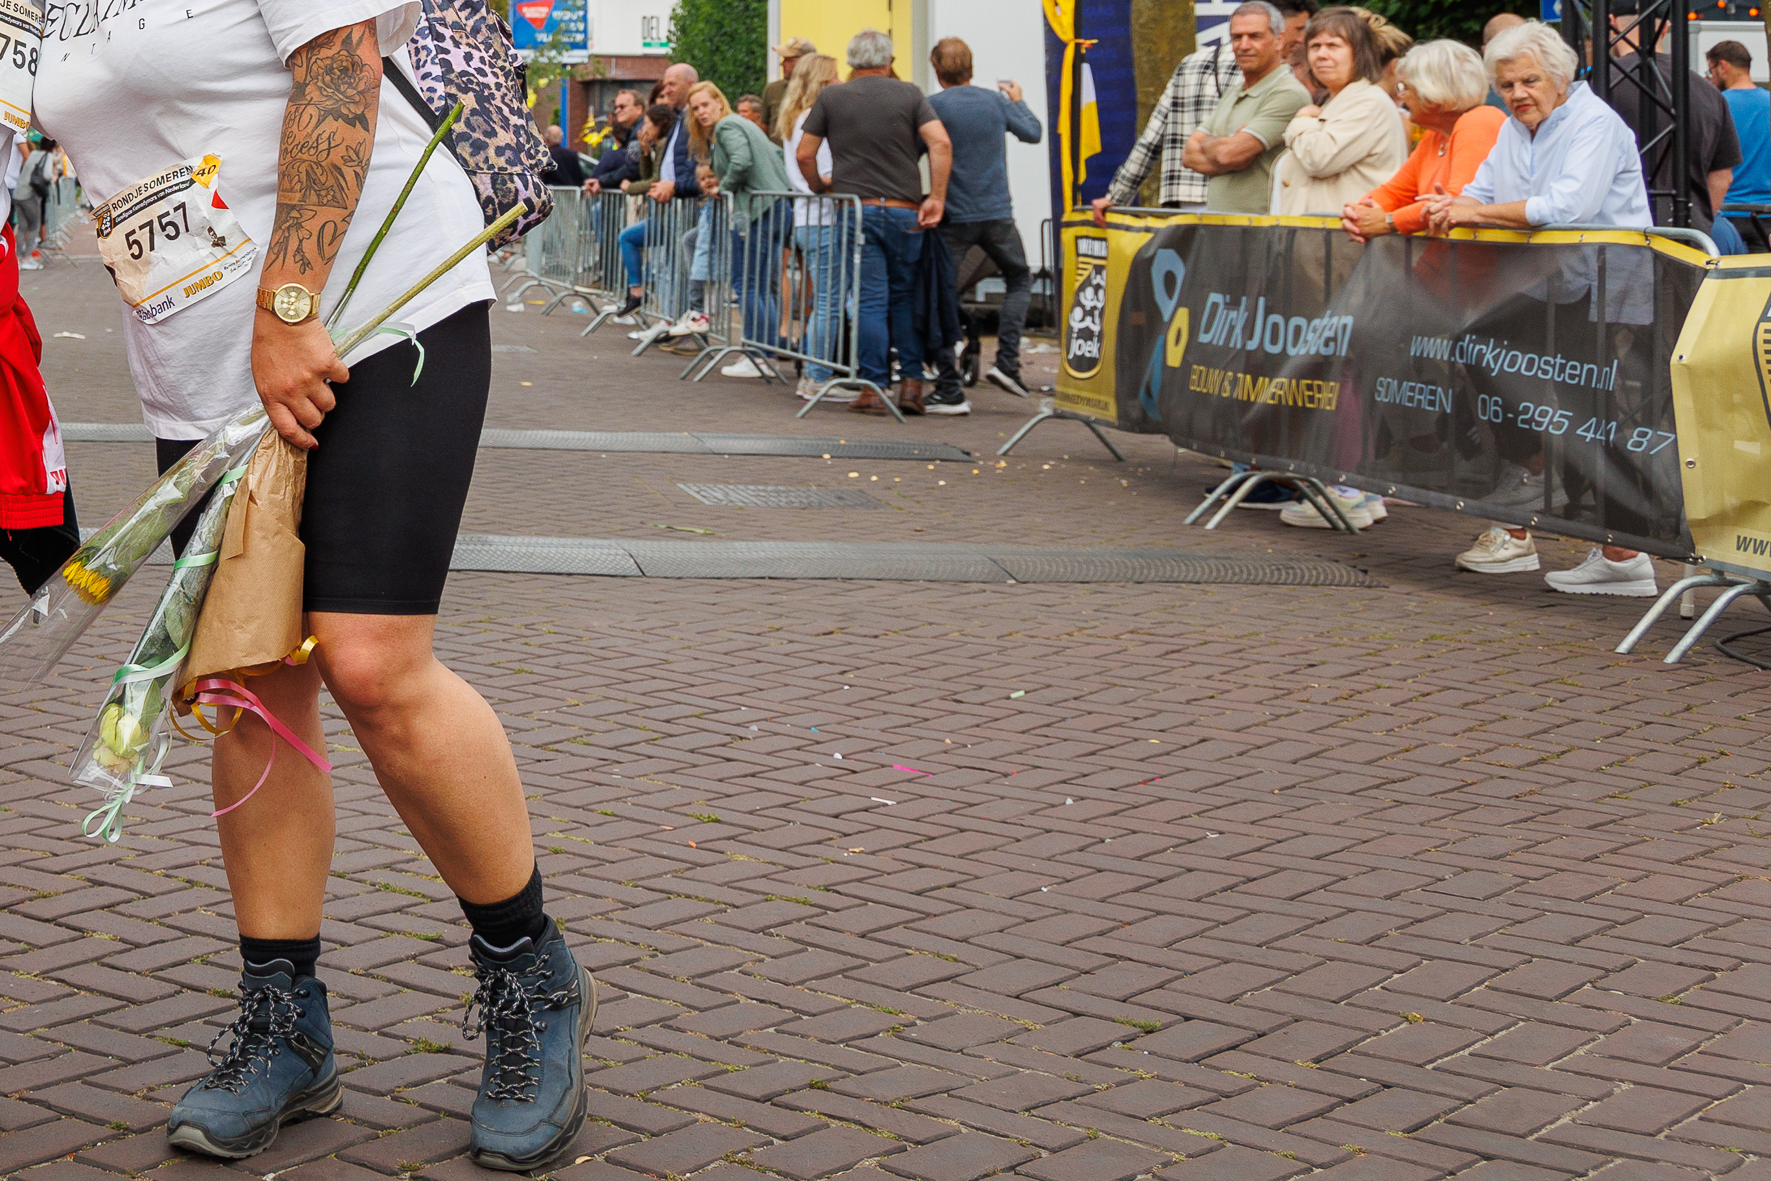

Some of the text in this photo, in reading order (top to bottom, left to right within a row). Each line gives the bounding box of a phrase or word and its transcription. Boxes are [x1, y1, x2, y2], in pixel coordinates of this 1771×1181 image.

[12, 4, 44, 26] SOMERE
[111, 186, 143, 213] RONDJE
[143, 164, 195, 193] SOMEREN
[195, 163, 218, 178] 40
[124, 201, 190, 261] 5757
[182, 270, 224, 299] JUMBO
[1068, 334, 1100, 360] joek
[1198, 292, 1355, 357] Dirk Joosten
[1410, 334, 1619, 392] www.dirkjoosten.nl
[1374, 376, 1453, 414] SOMEREN
[1626, 426, 1677, 455] 87
